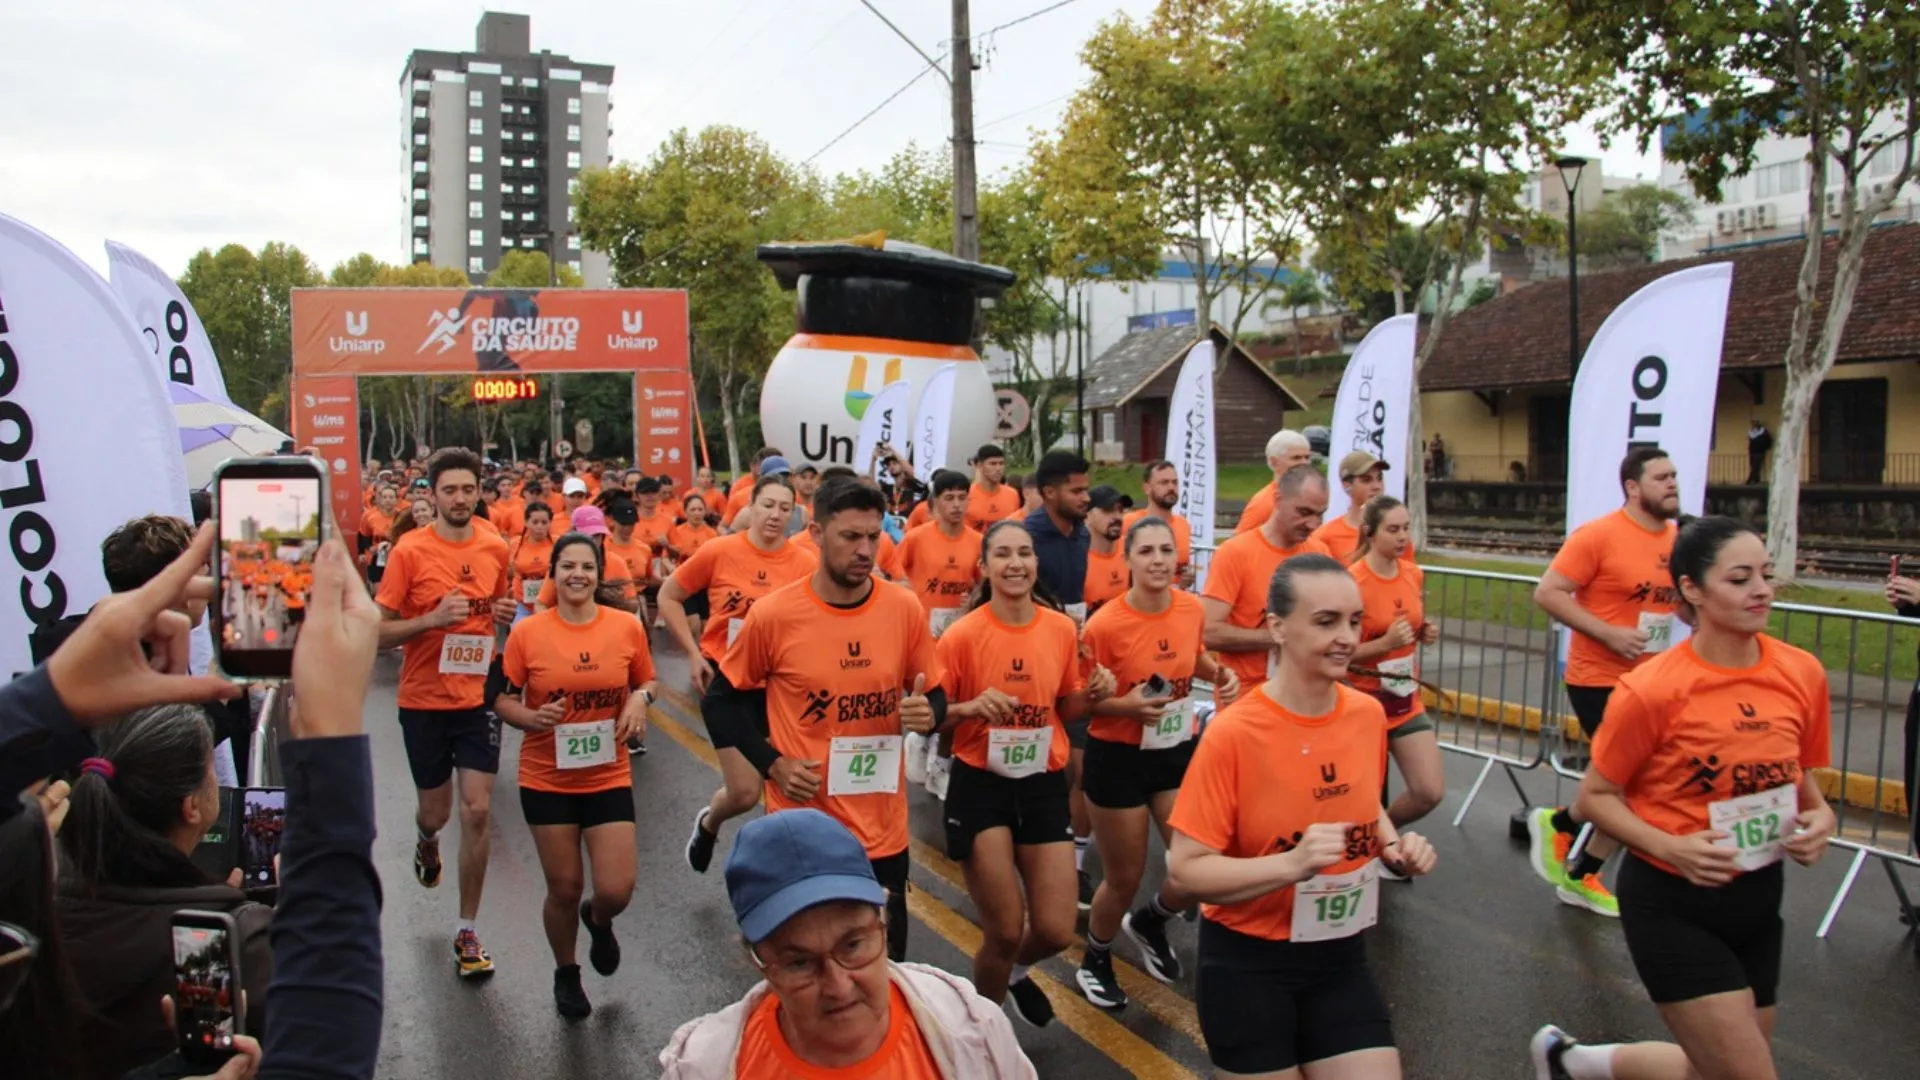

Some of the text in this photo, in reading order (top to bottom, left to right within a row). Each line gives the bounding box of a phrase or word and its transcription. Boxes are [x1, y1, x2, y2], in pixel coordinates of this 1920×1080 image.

[345, 310, 368, 336] U
[471, 317, 580, 335] CIRCUITO
[622, 310, 643, 334] U
[330, 336, 385, 355] Uniarp
[472, 333, 577, 351] DA SAÚDE
[607, 334, 658, 352] Uniarp
[1352, 411, 1369, 452] RIA
[1367, 399, 1385, 457] ÃO
[446, 646, 484, 663] 1038
[838, 708, 860, 722] DA
[568, 735, 600, 756] 219
[1002, 744, 1036, 764] 164
[848, 753, 877, 777] 42
[1732, 813, 1780, 849] 162
[1314, 888, 1362, 922] 197
